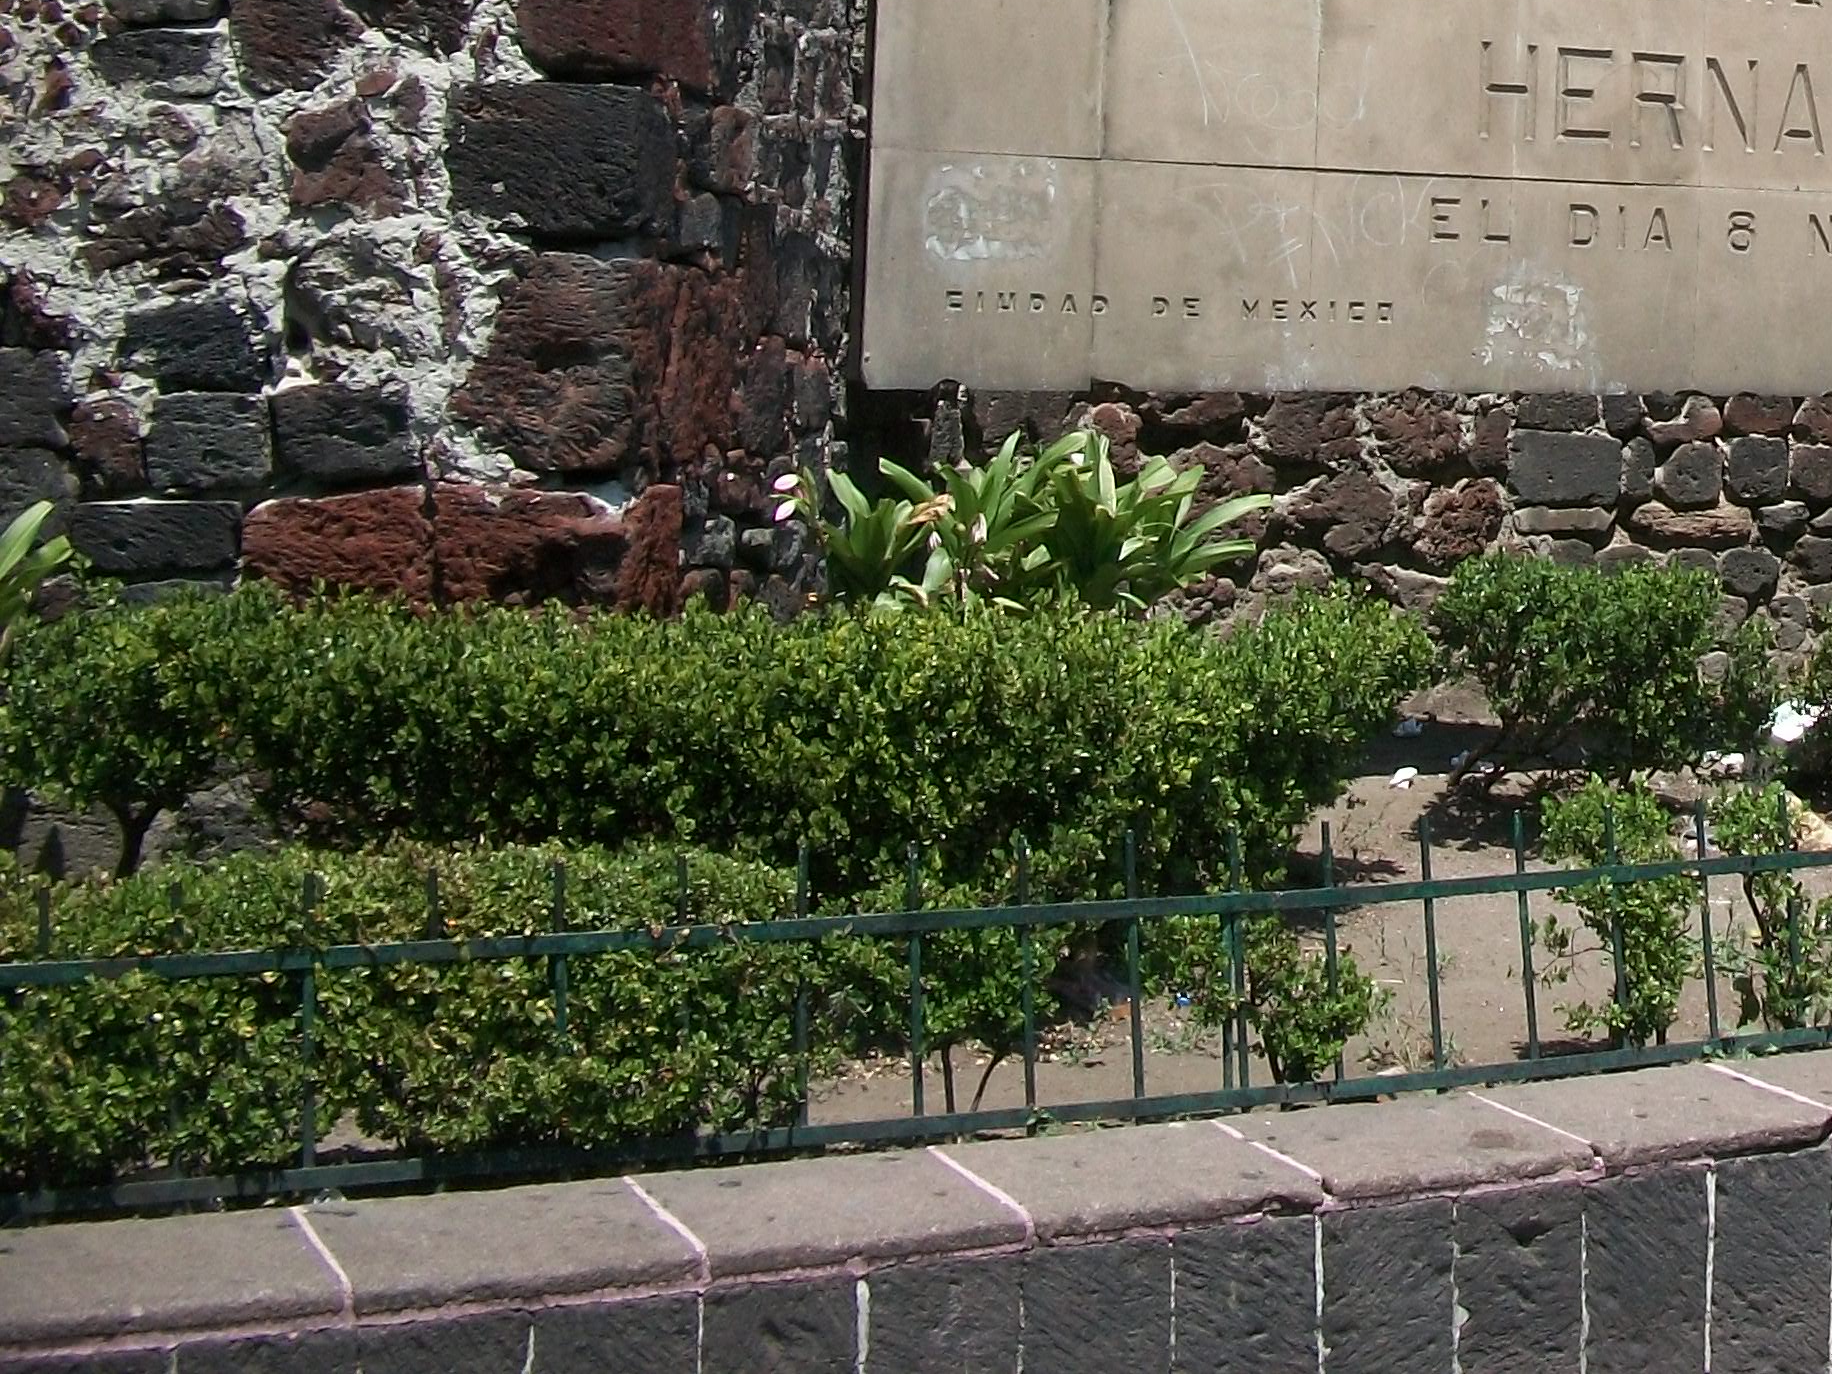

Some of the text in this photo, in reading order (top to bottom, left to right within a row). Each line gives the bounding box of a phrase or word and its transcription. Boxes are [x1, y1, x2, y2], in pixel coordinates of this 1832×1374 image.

[1428, 196, 1513, 245] EL
[1568, 202, 1675, 254] DIA
[1726, 209, 1758, 256] 8
[943, 289, 1395, 326] CIUDAD DE MEXICO
